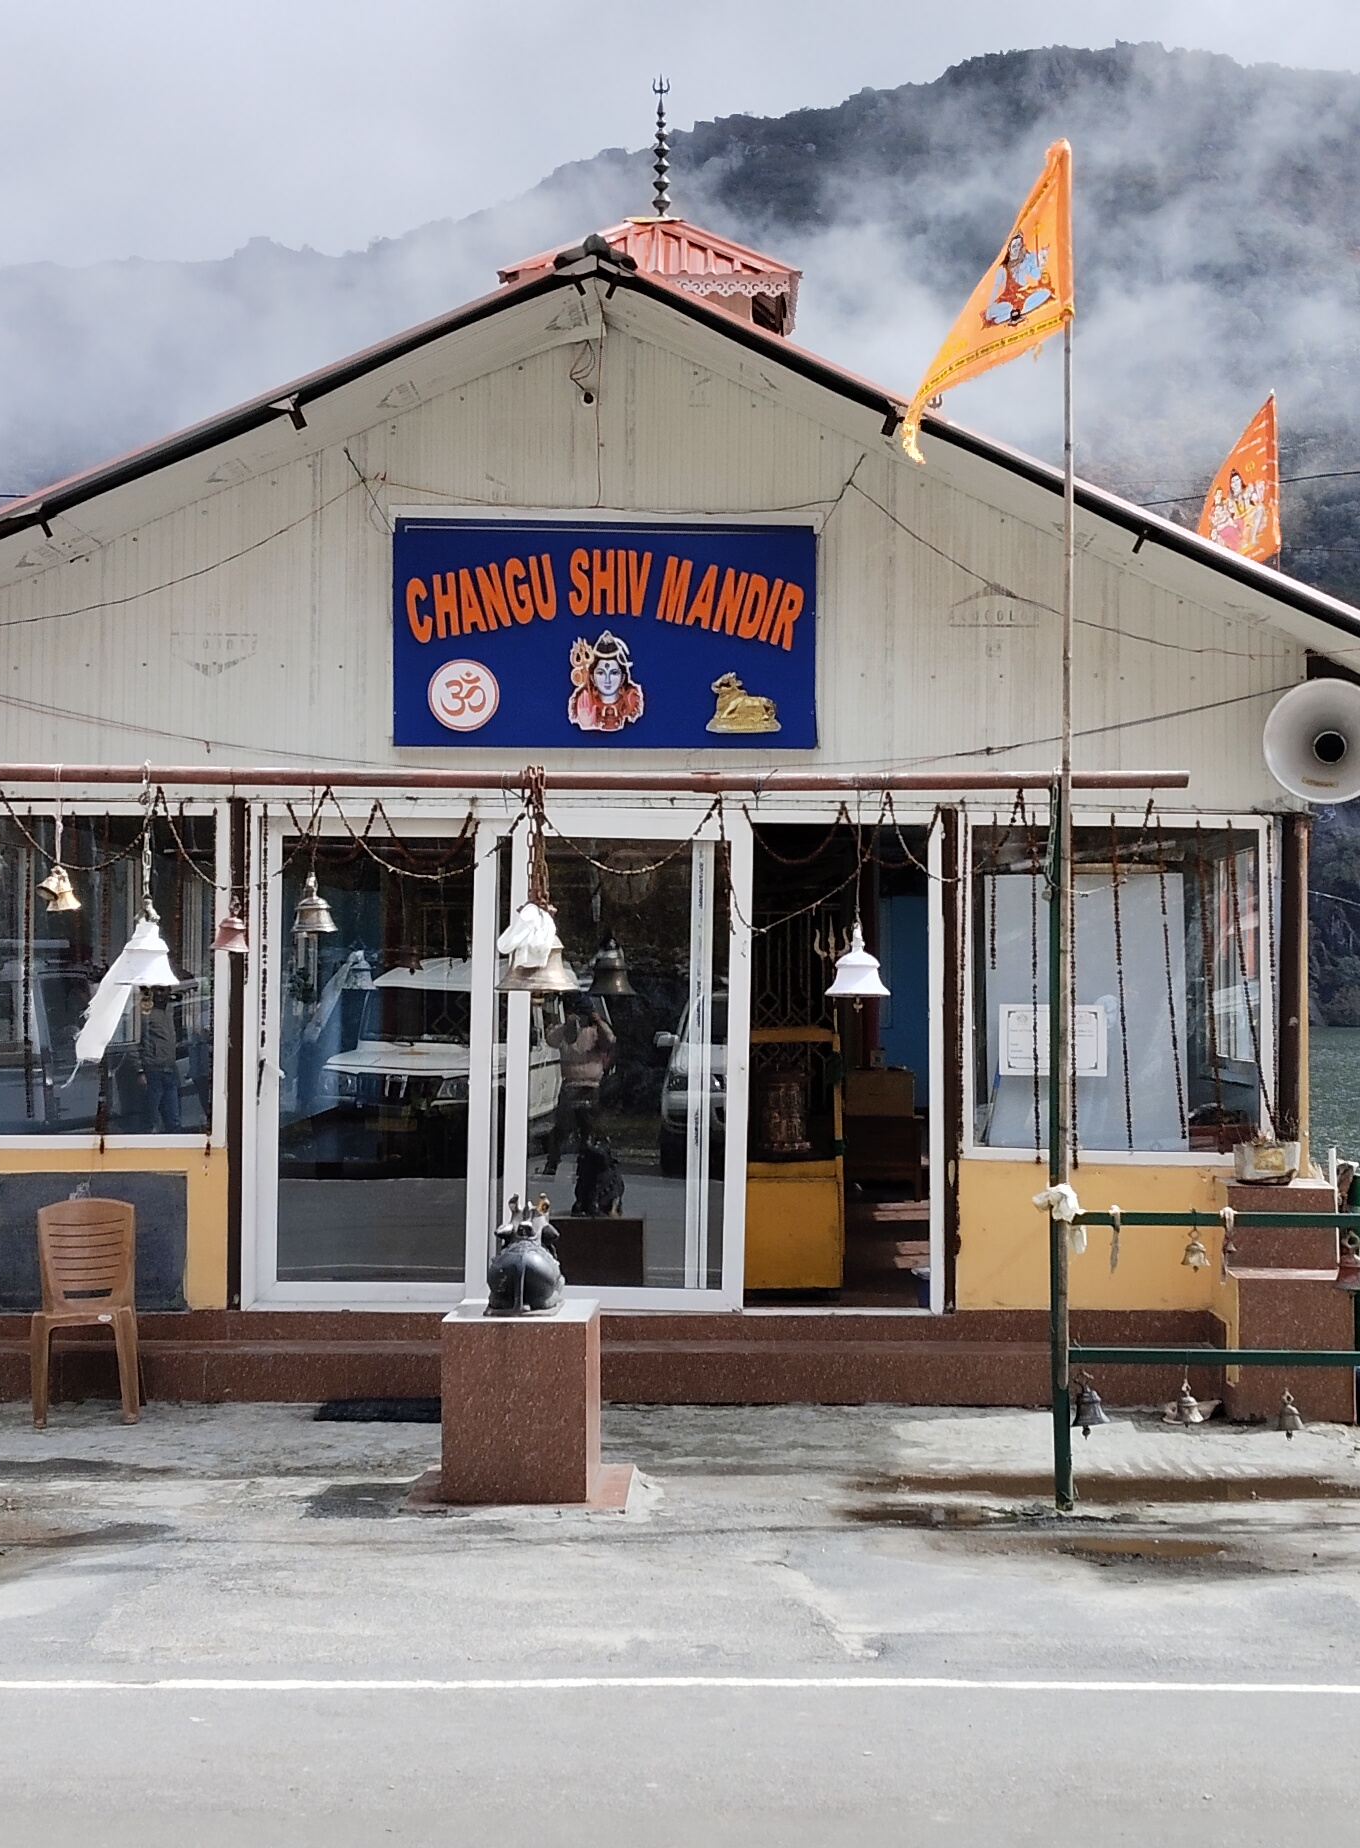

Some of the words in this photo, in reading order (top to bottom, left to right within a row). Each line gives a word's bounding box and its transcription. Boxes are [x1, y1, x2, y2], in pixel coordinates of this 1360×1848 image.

[406, 553, 557, 643] CHANGU
[569, 548, 653, 617] SHIV
[656, 555, 805, 651] MANDIR
